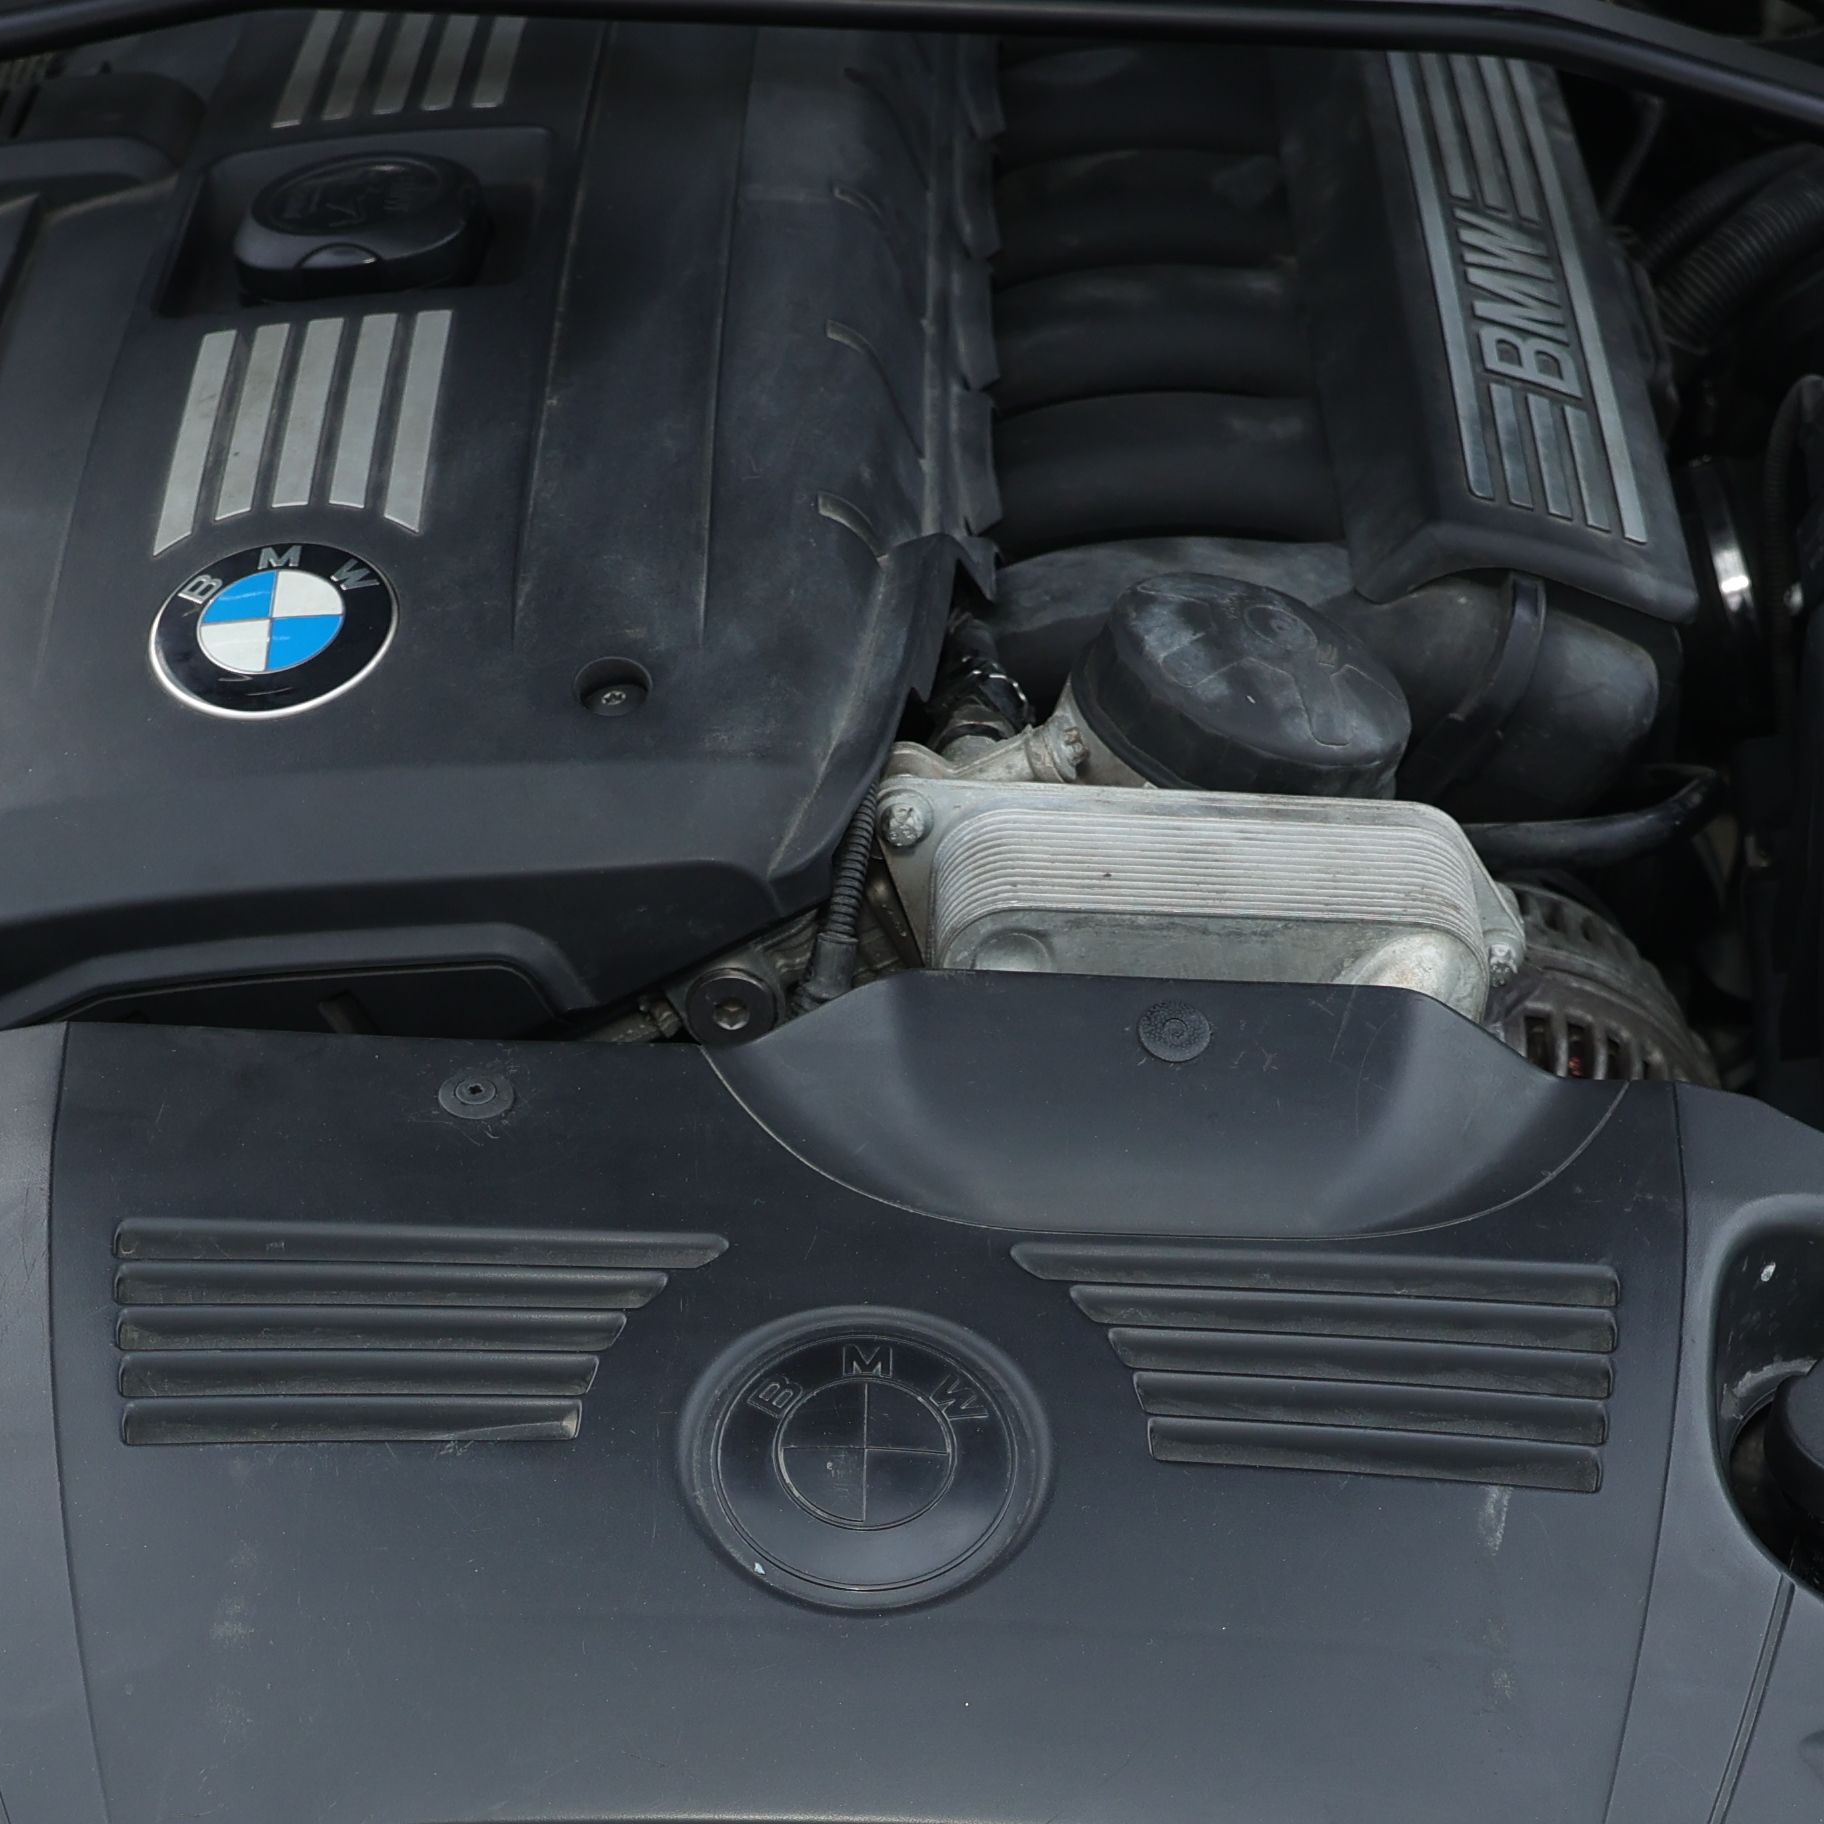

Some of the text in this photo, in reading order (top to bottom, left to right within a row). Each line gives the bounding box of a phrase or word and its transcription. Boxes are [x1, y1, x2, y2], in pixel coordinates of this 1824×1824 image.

[1453, 206, 1584, 401] BMW
[177, 544, 380, 605] BMW
[747, 1343, 990, 1419] BMW
